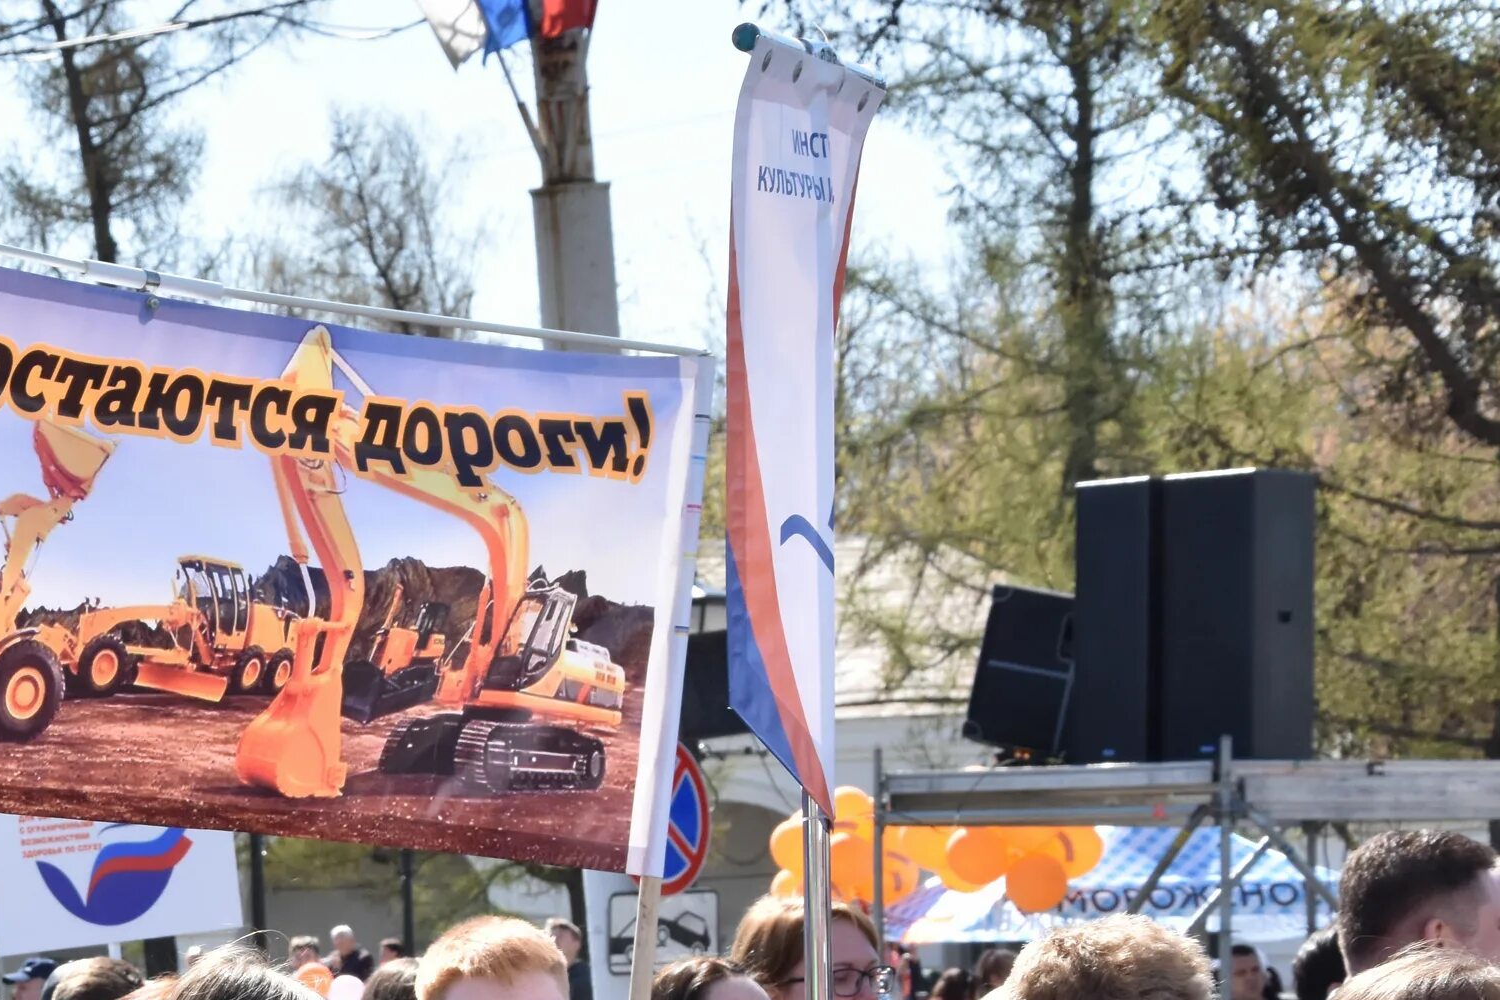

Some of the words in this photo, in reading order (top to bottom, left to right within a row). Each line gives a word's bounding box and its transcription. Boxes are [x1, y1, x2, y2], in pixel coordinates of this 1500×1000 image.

[791, 129, 831, 158] ИНСТ
[757, 165, 825, 202] КУЛЬТУРЫ
[355, 396, 654, 488] дороги!
